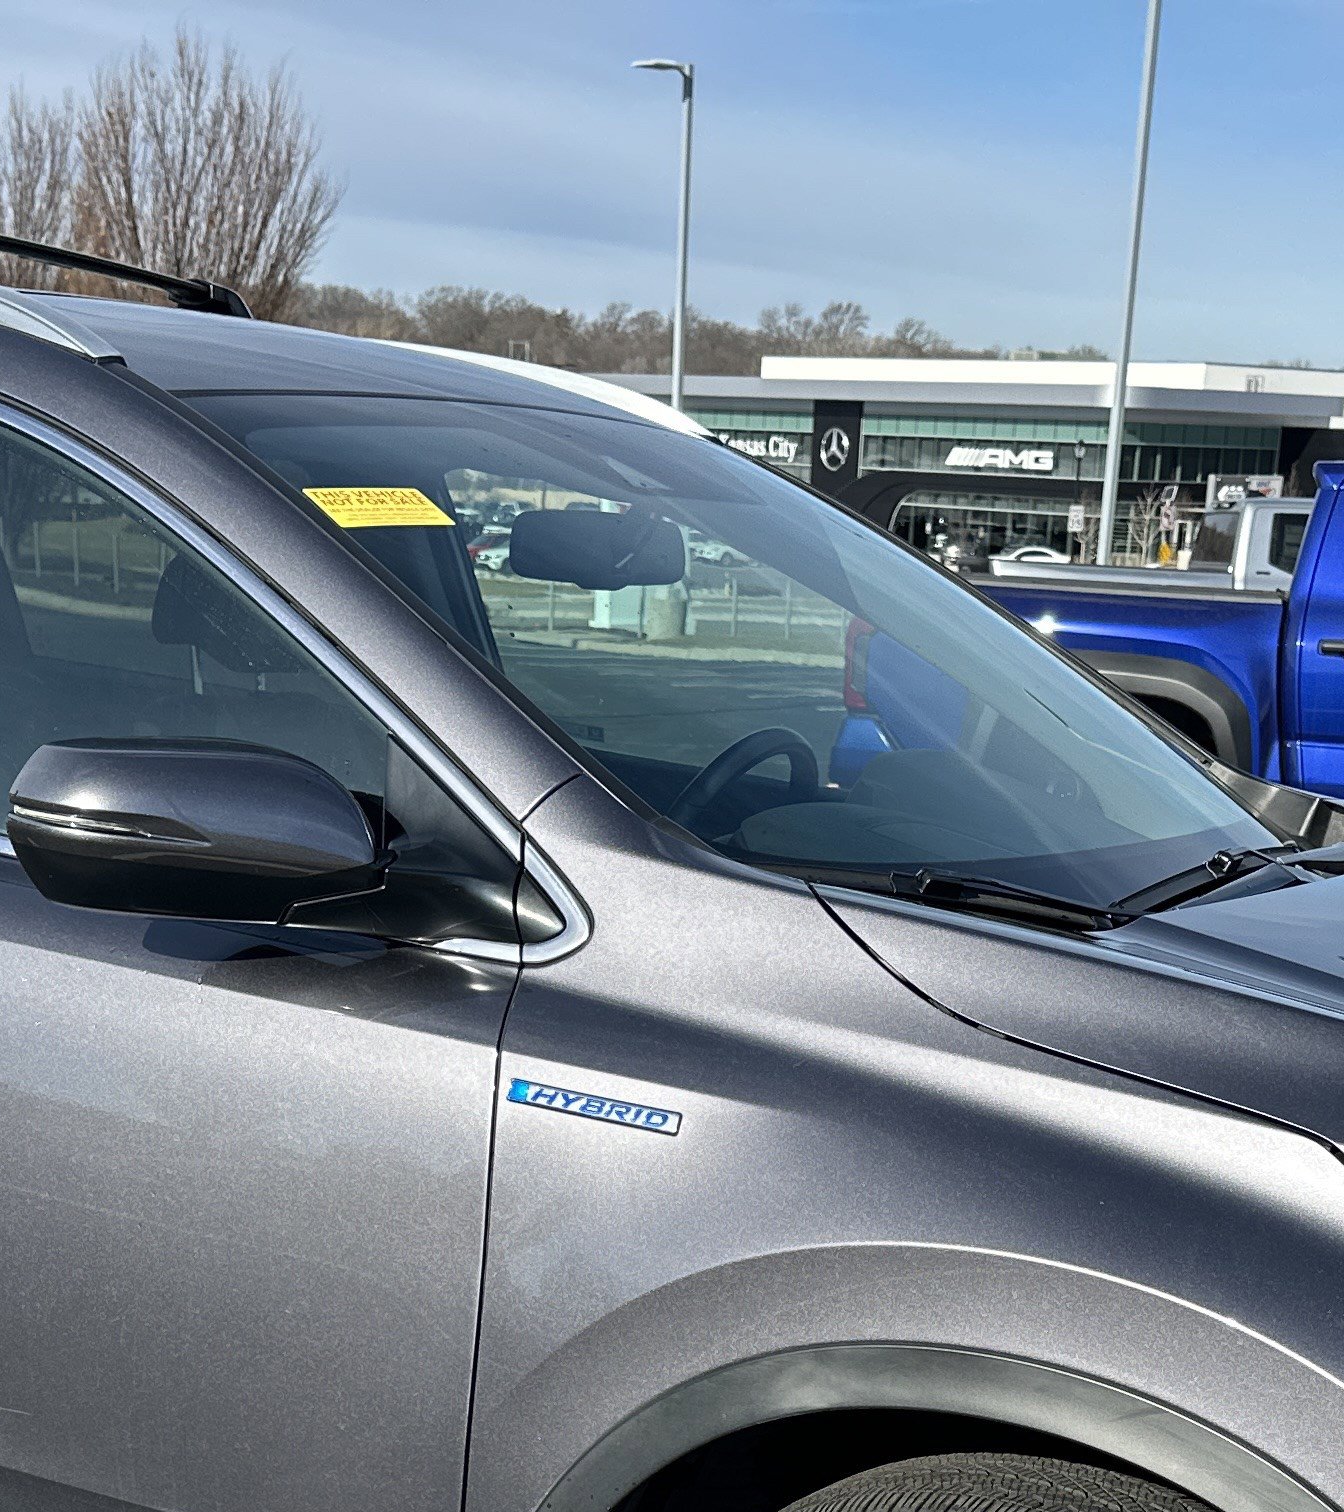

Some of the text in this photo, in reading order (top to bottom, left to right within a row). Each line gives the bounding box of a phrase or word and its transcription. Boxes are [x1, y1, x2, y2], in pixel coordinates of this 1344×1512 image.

[769, 436, 798, 463] City
[311, 490, 422, 499] THIS VEHICLE
[531, 1088, 669, 1127] HYBRID
